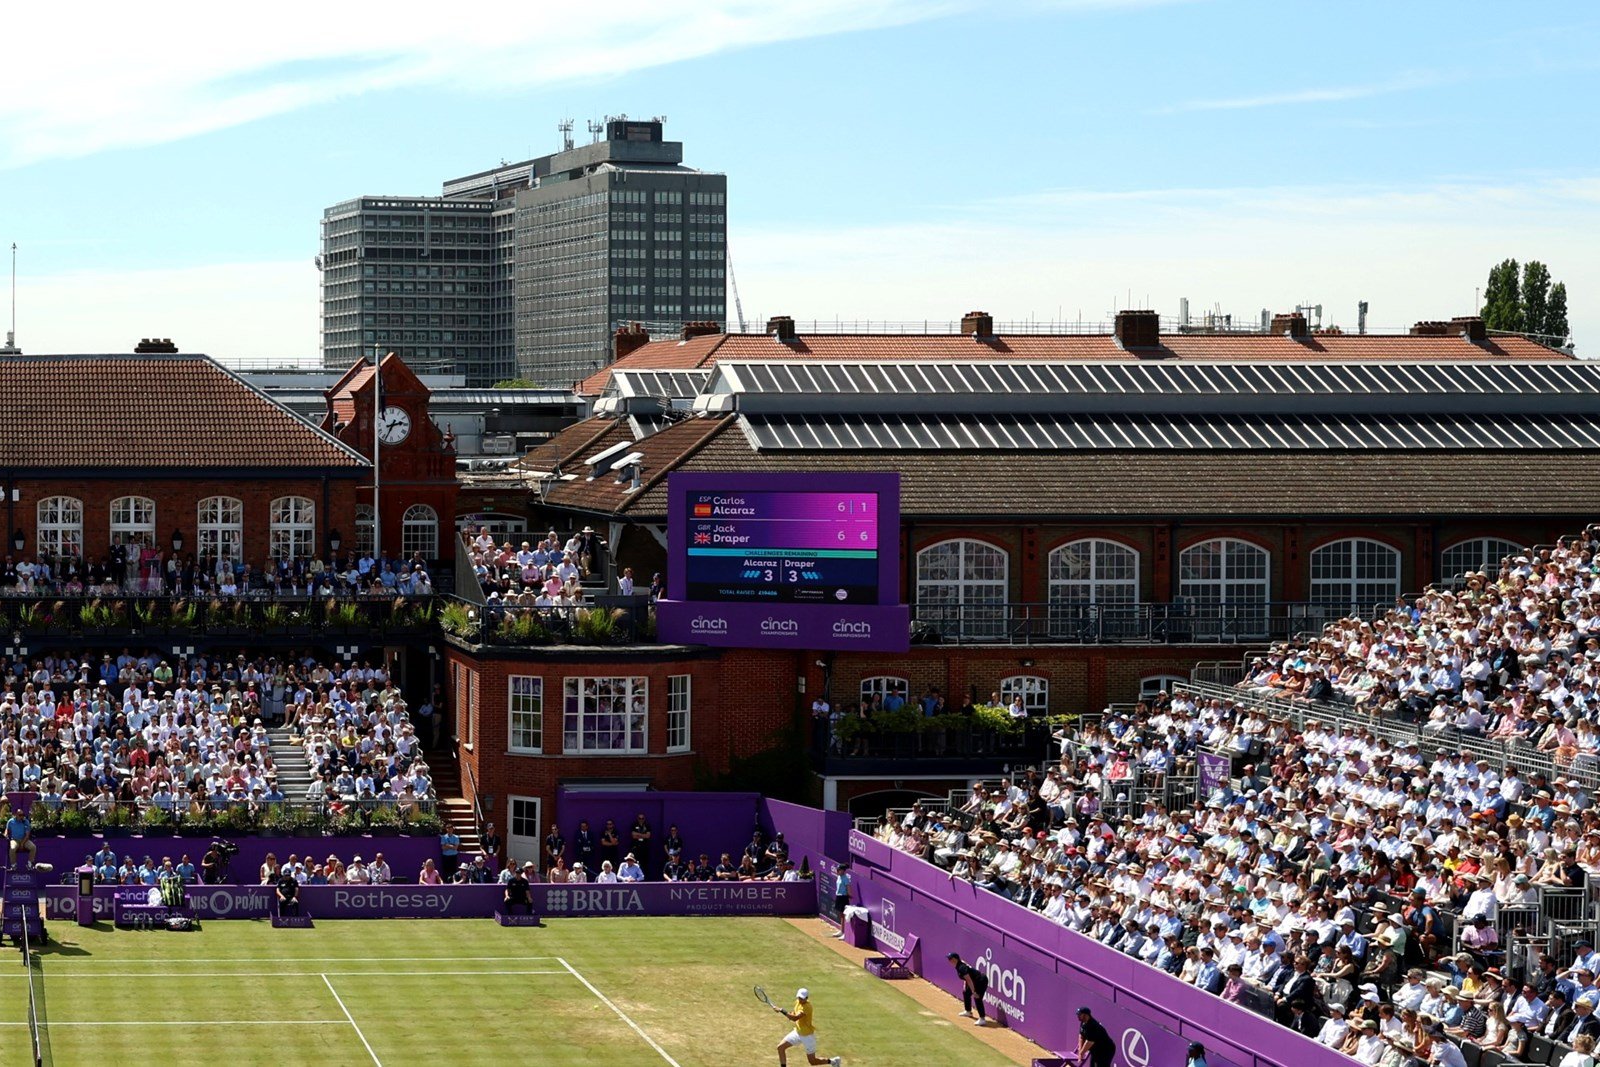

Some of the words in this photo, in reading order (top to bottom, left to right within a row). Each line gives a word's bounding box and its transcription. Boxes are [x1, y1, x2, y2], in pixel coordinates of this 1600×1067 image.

[713, 496, 745, 505] Carlos
[713, 506, 755, 515] Alcaraz
[837, 502, 846, 512] 6
[861, 502, 867, 512] 1
[713, 524, 736, 533] Jack
[713, 534, 750, 544] Draper
[837, 531, 846, 541] 6
[859, 531, 868, 541] 6
[744, 559, 778, 567] Alcaraz
[784, 560, 815, 568] Draper
[764, 570, 773, 582] 3
[788, 570, 798, 582] 3
[691, 616, 727, 629] cinch
[761, 617, 798, 630] cinch
[833, 619, 870, 632] cinch
[849, 832, 866, 852] cinch
[572, 890, 644, 910] BRITA
[670, 888, 786, 900] NYETIMBER
[190, 896, 208, 909] NIS
[334, 890, 453, 912] Rothesay
[122, 910, 150, 920] cinch
[154, 910, 182, 920] cinch
[976, 948, 1025, 1005] cinch
[984, 991, 1024, 1022] AMPIONSHIPS
